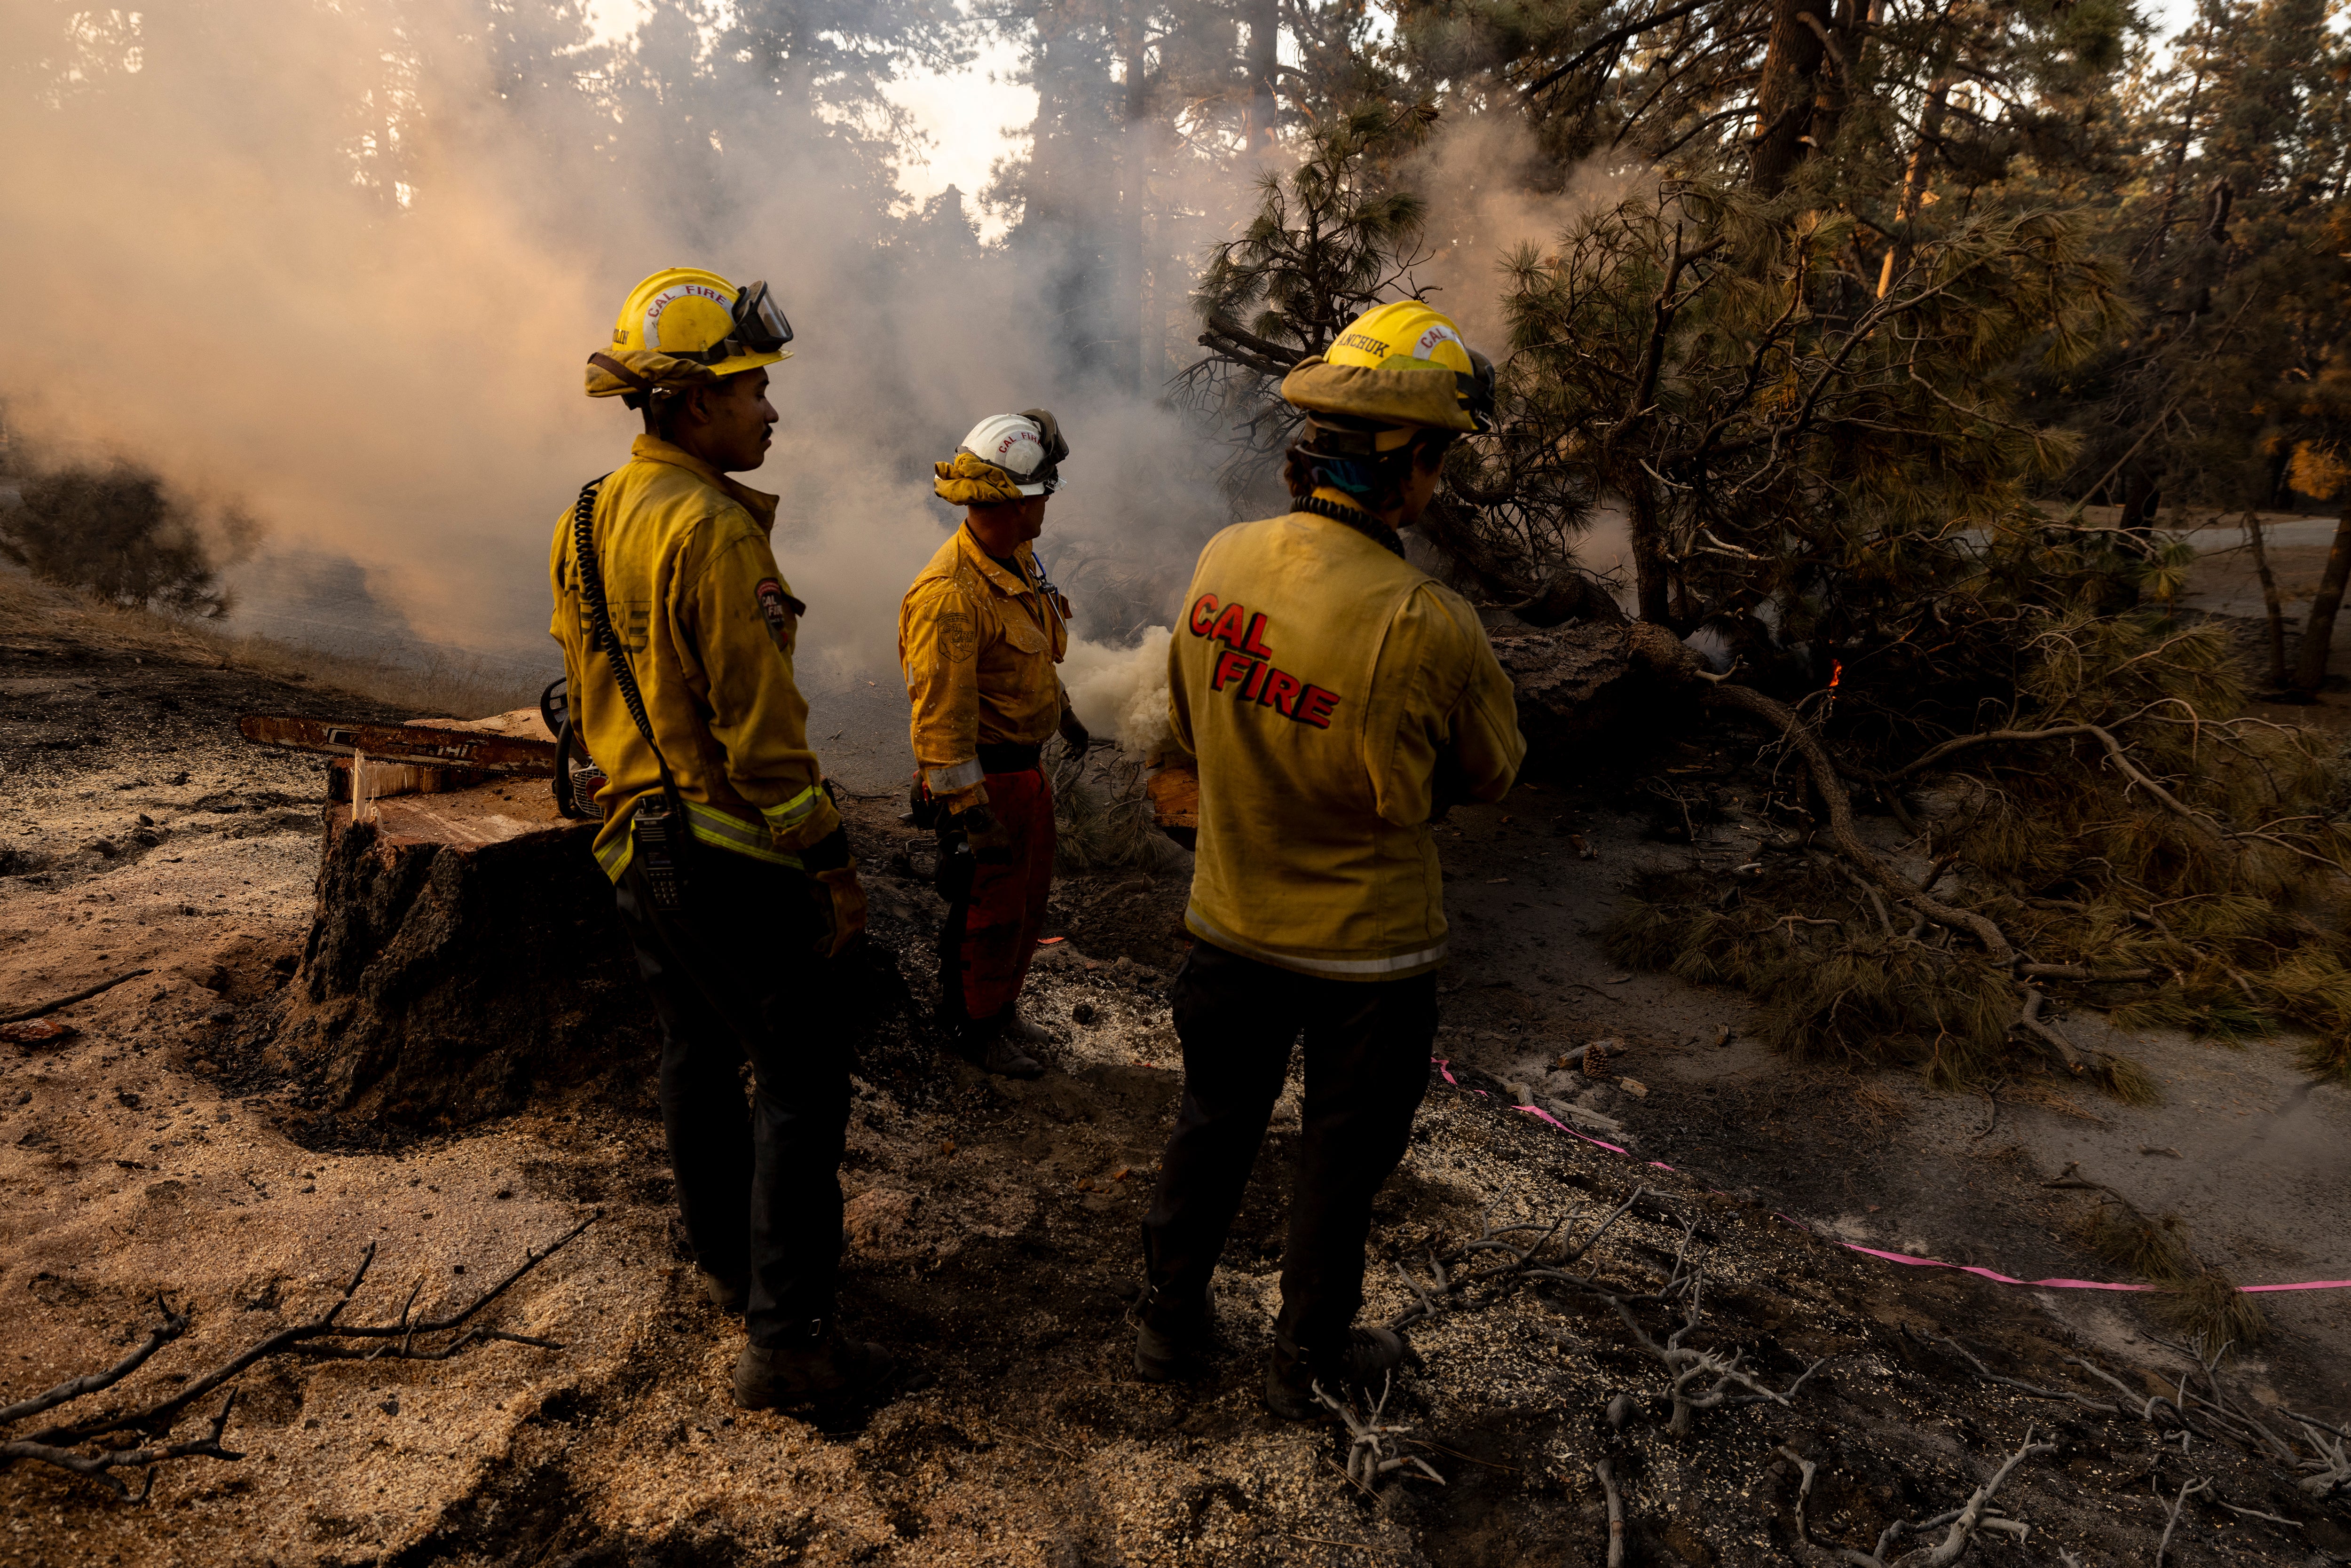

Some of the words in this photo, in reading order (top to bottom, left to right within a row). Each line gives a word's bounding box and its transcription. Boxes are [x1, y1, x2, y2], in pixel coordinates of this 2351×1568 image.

[647, 293, 675, 317] CAL
[685, 285, 726, 306] FIRE
[1420, 328, 1447, 348] CAL
[999, 436, 1017, 453] CAL
[762, 595, 777, 607] CAL
[578, 599, 652, 654] FRE
[943, 623, 962, 632] CAL
[952, 630, 974, 639] FIRE
[1189, 593, 1272, 661] CAL
[1211, 650, 1341, 730] FIRE
